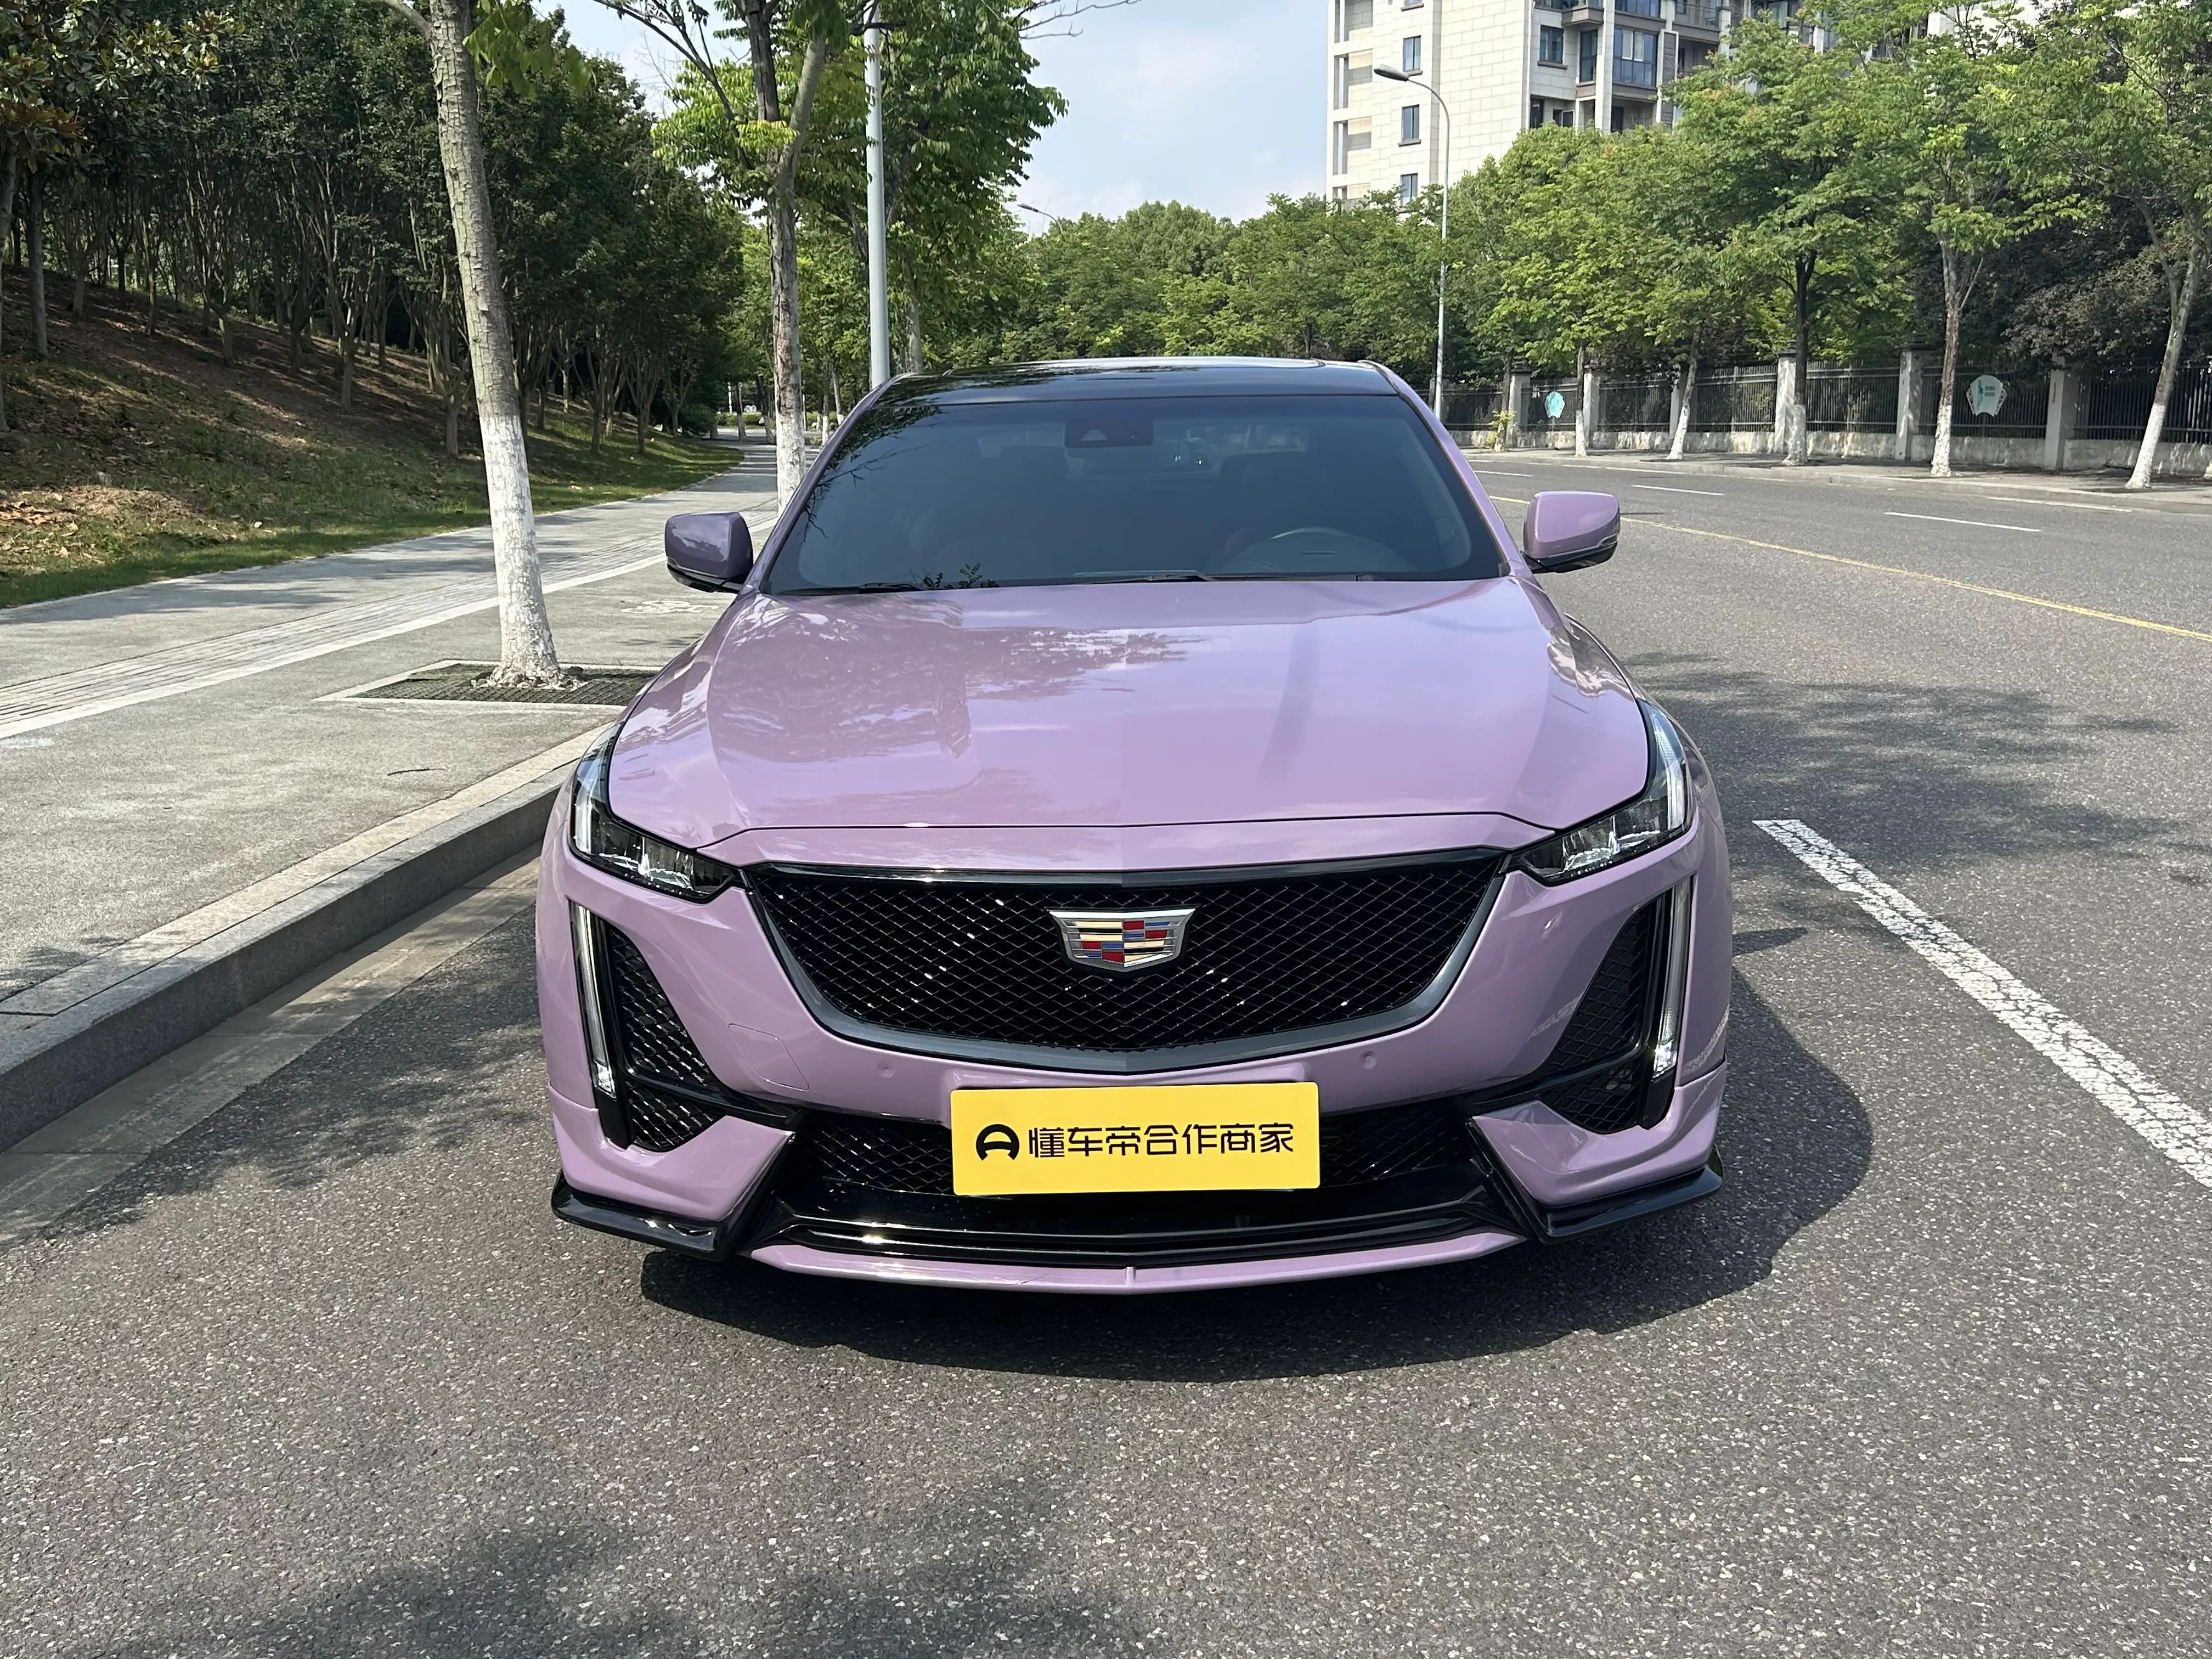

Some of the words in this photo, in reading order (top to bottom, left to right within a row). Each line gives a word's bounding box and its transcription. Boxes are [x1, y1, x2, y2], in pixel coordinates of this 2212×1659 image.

[1029, 1122, 1294, 1158] 懂车帝合作商家
